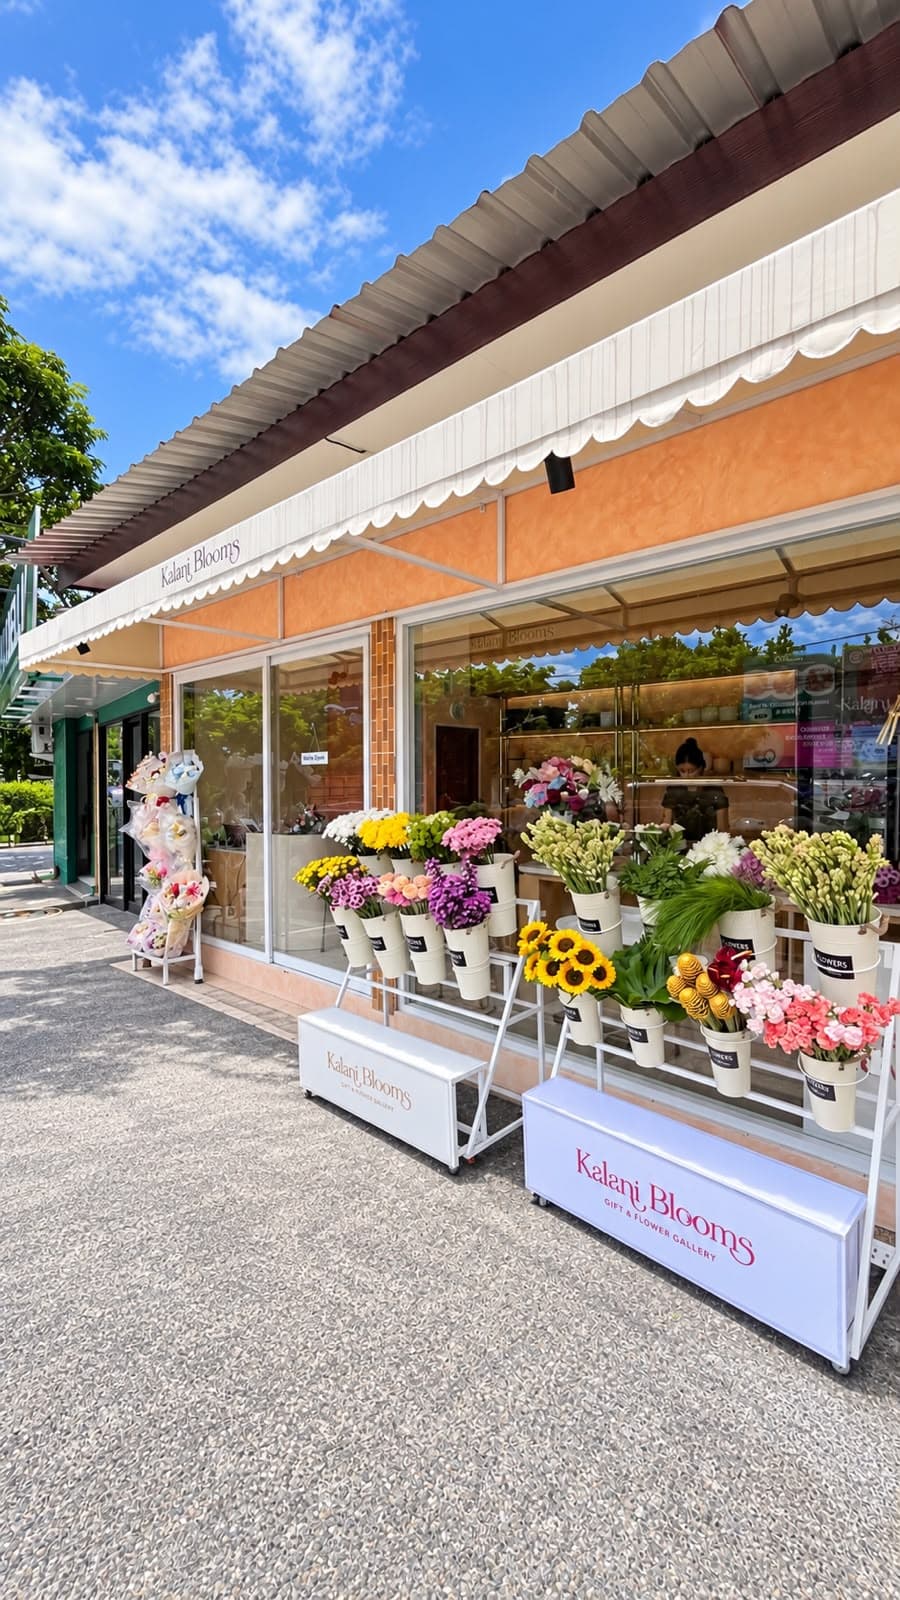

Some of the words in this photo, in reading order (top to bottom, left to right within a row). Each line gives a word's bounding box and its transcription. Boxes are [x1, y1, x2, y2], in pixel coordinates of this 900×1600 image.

[161, 557, 193, 588] Kalani
[194, 538, 241, 573] Blooms
[327, 1051, 362, 1088] Kalani
[362, 1066, 412, 1111] Blooms
[576, 1148, 647, 1213] Kalani
[650, 1183, 756, 1266] Blooms
[604, 1198, 624, 1213] GIFT
[626, 1210, 632, 1218] &
[634, 1213, 670, 1238] FLOWER
[673, 1234, 717, 1262] GALLERY
